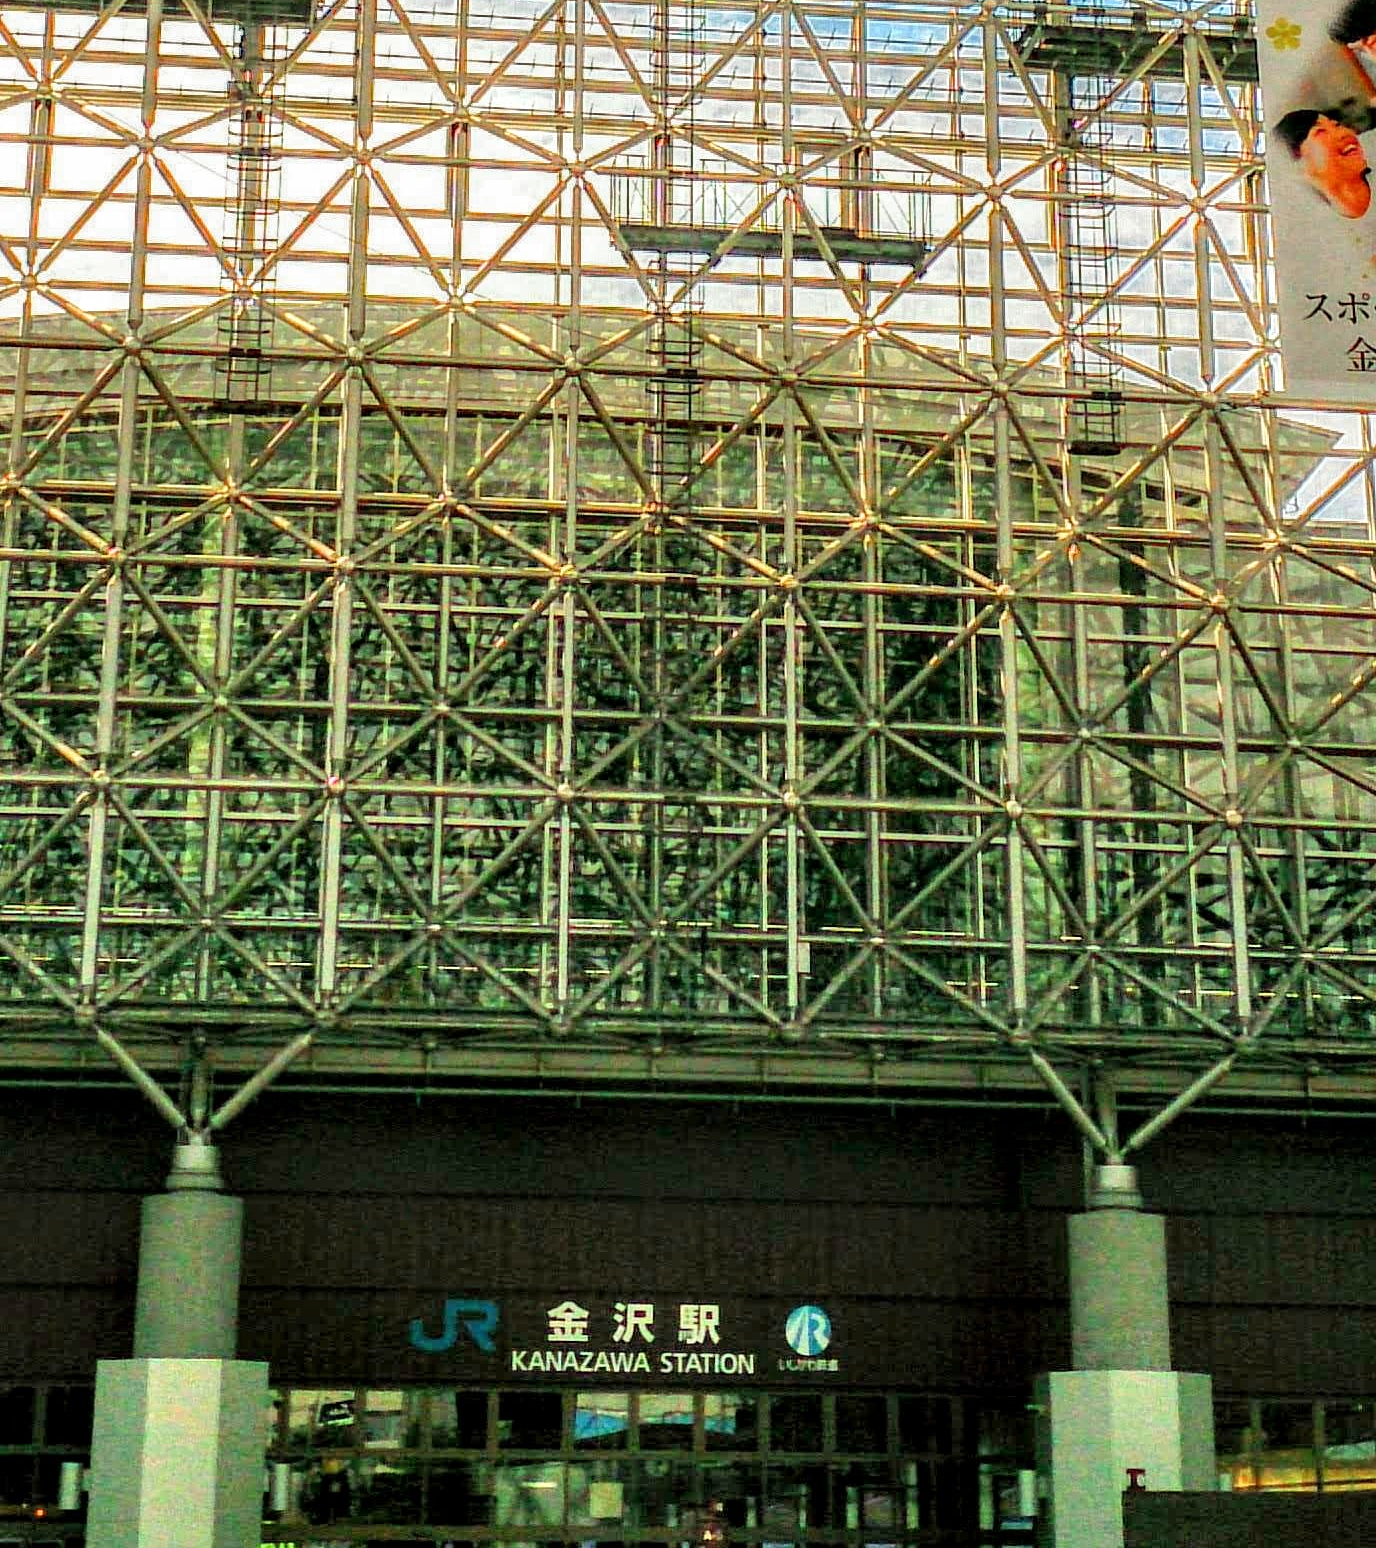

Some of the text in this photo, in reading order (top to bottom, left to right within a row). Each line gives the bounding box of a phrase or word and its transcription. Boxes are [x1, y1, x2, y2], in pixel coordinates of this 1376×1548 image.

[408, 1299, 500, 1352] JR
[546, 1301, 722, 1345] 金沢駅
[511, 1350, 755, 1375] KANAZAWA STATION
